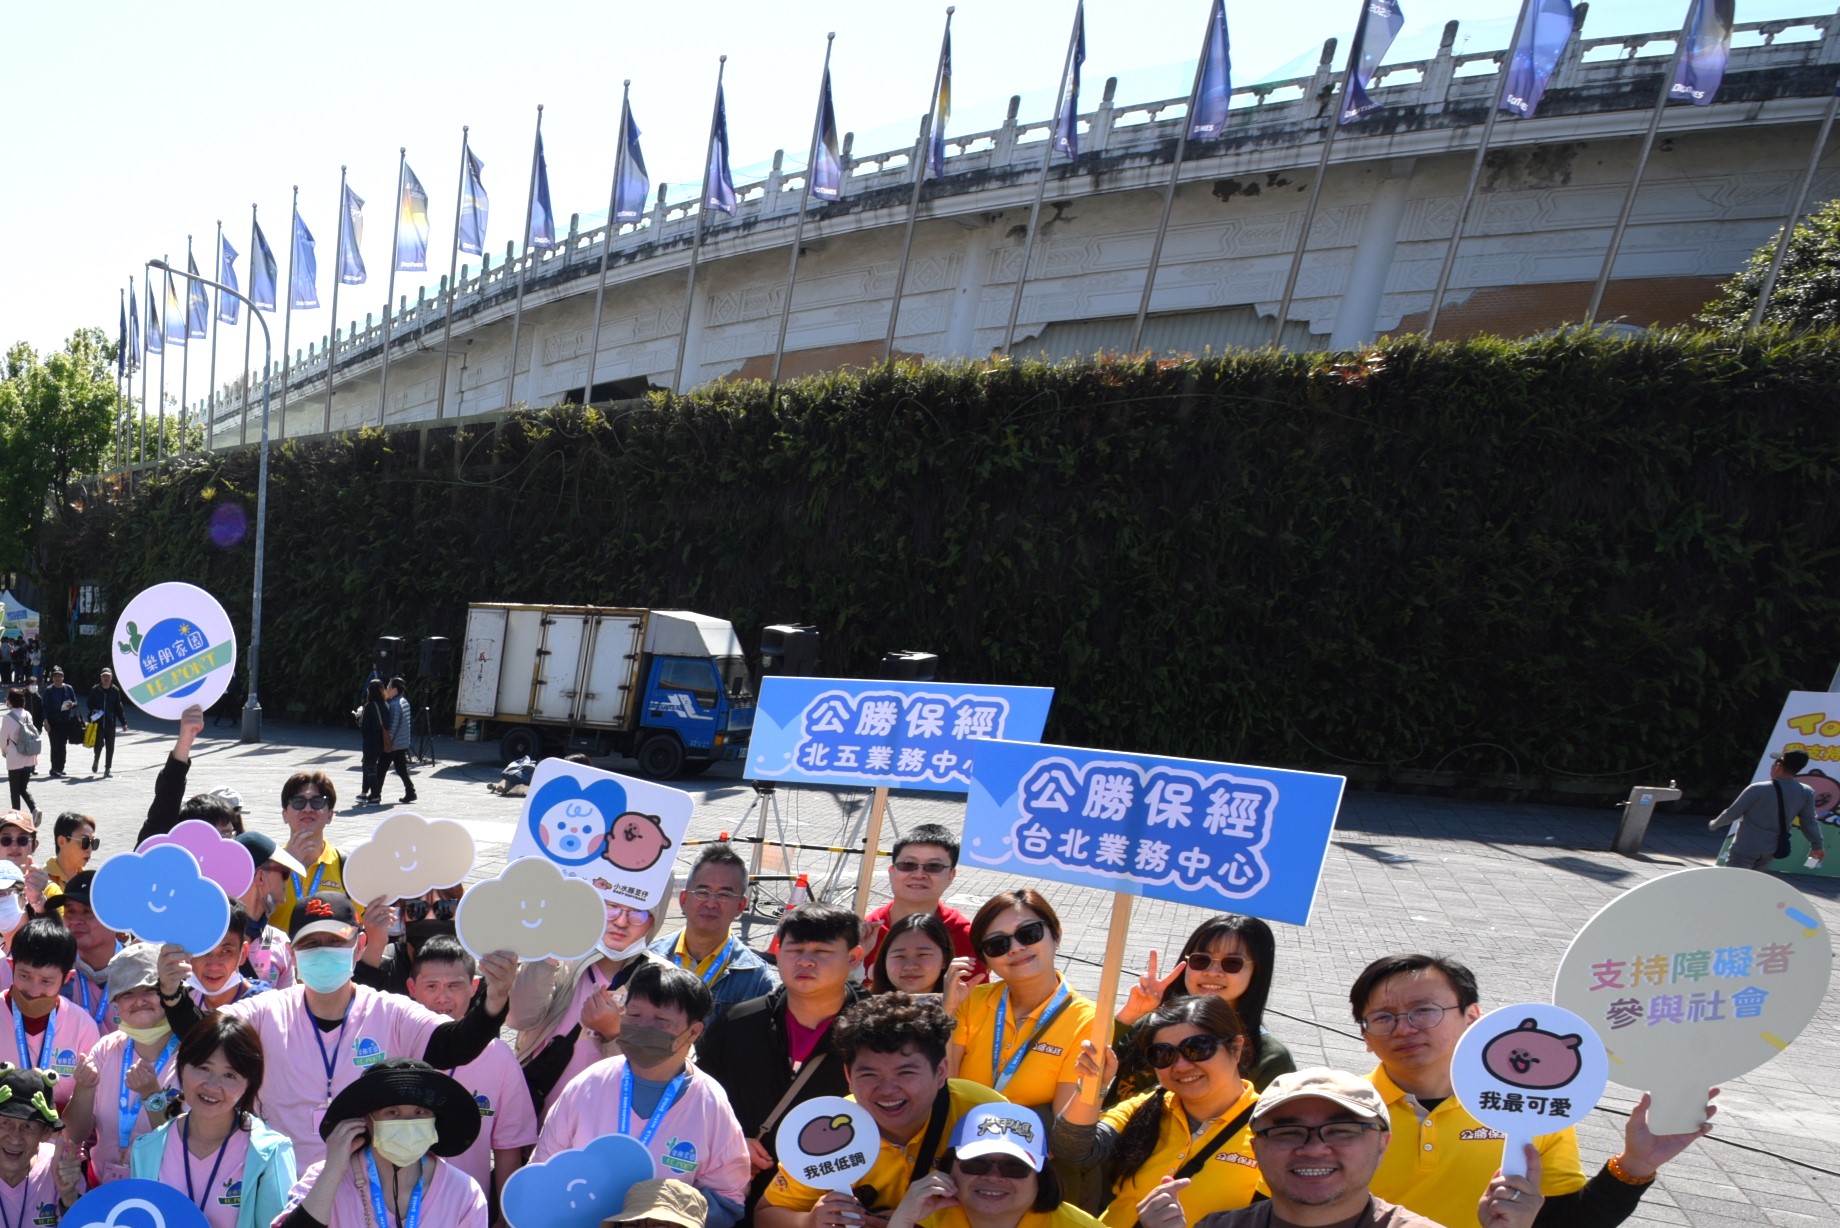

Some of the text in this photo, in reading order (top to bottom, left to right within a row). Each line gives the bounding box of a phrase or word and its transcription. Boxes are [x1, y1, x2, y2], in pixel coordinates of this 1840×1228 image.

[142, 631, 204, 672] 樂朋家園
[146, 652, 217, 697] LE PORT
[811, 700, 998, 741] 公勝保經
[802, 742, 974, 774] 北五業務中
[1030, 769, 1262, 839] 公勝保經
[1022, 822, 1255, 886] 台北業務中心
[1588, 941, 1796, 992] 支持障礙者
[1606, 985, 1770, 1031] 參與社會
[1478, 1090, 1572, 1118] 我最可愛
[803, 1151, 867, 1180] 我很低調
